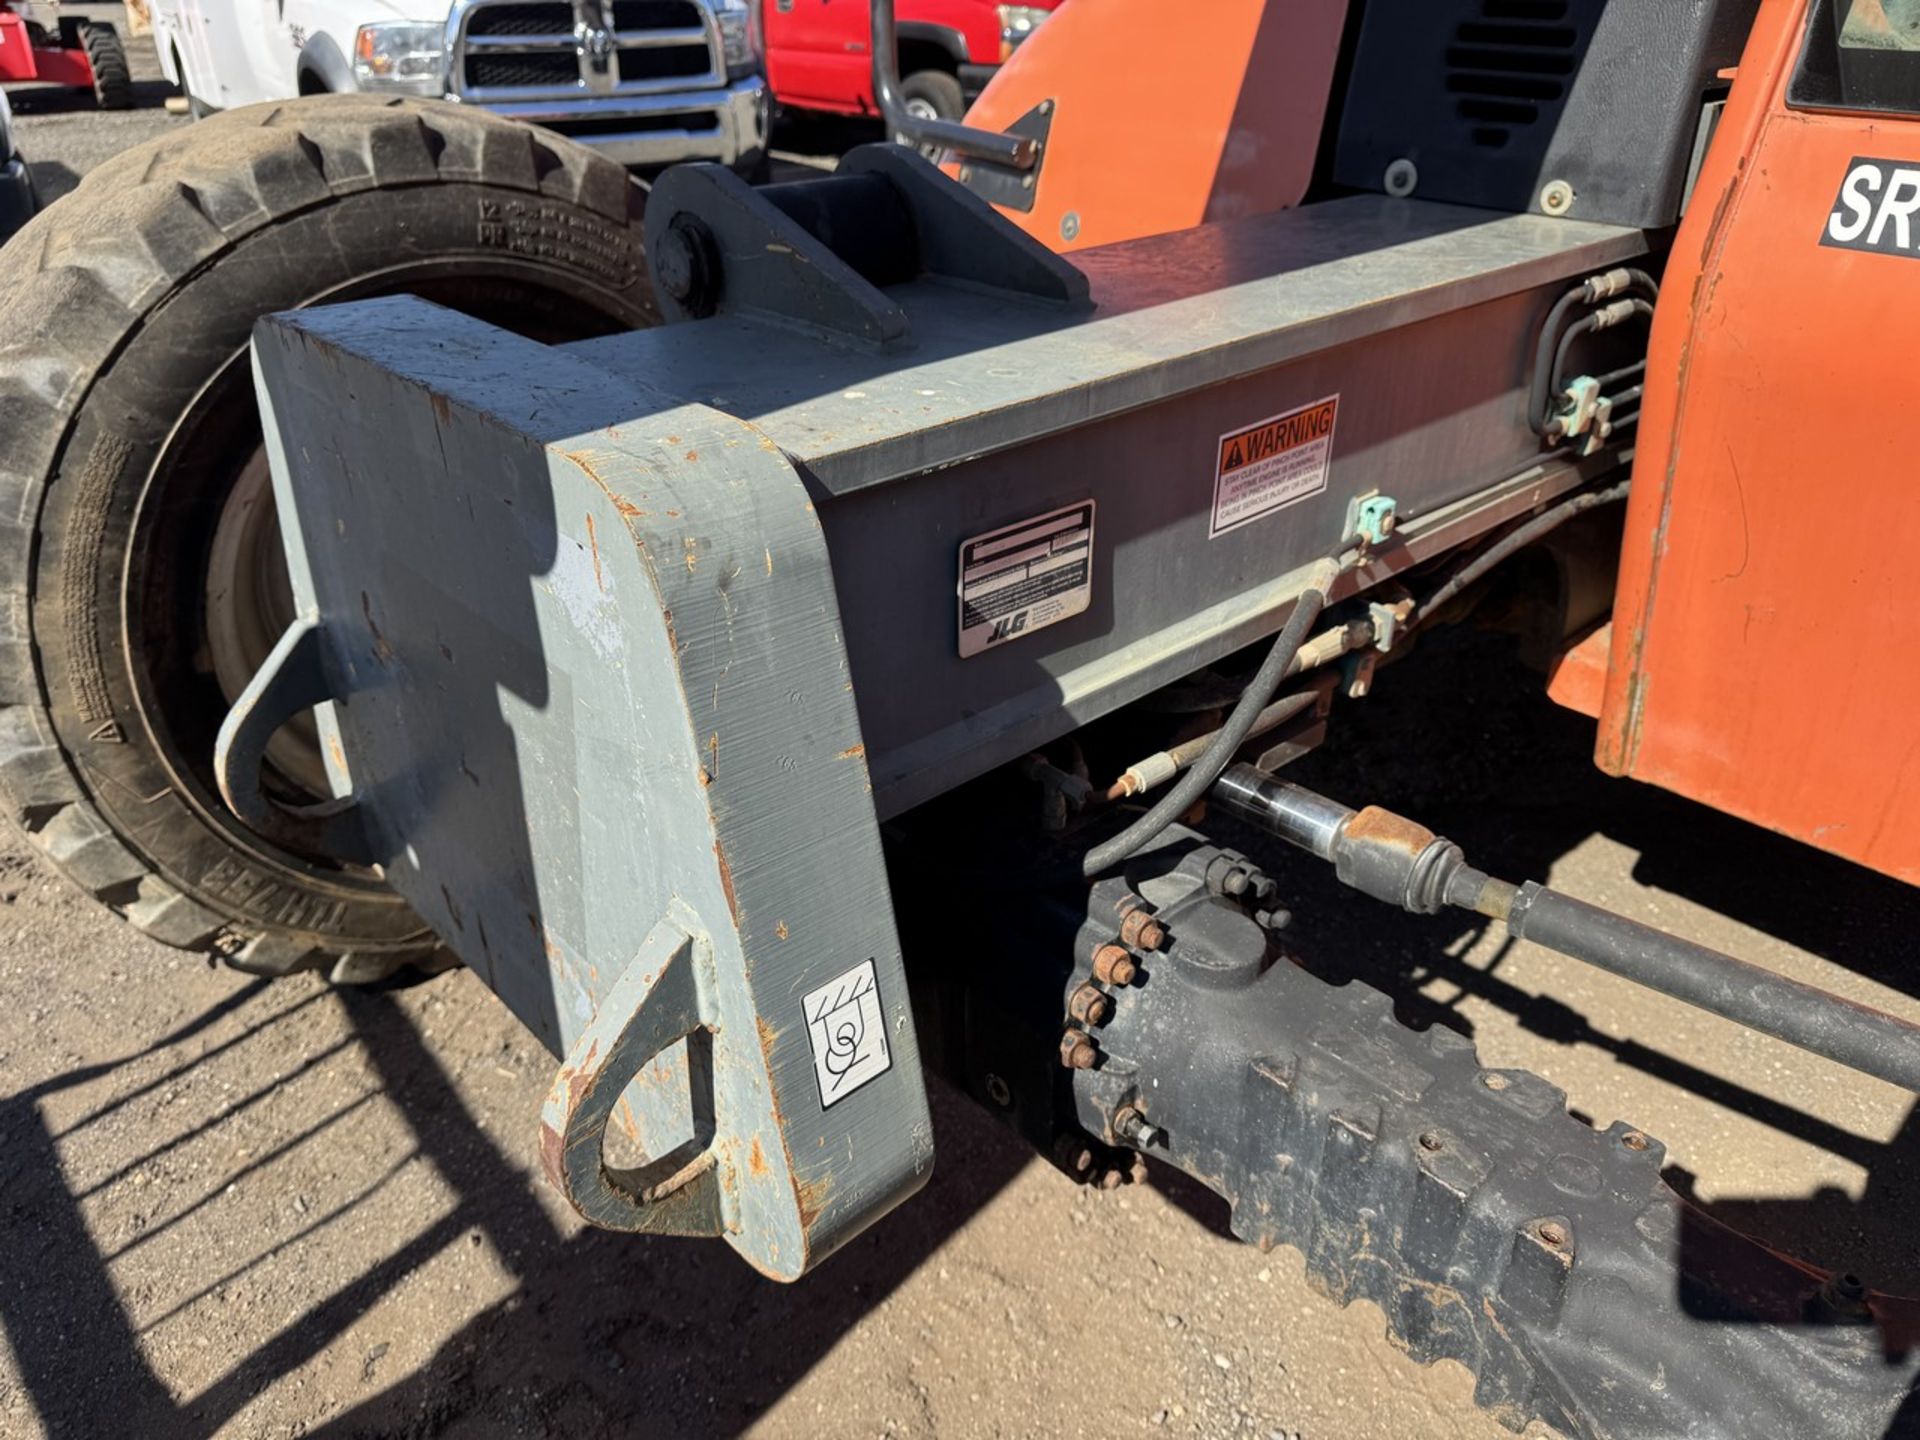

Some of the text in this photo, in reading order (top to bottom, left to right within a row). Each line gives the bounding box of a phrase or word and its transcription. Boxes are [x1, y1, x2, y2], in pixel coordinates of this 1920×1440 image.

[1828, 164, 1920, 249] SR
[1246, 406, 1331, 462] WARNING
[1241, 465, 1260, 480] CLEAR
[1271, 454, 1289, 467] PINCH
[1290, 446, 1308, 460] POINT
[1309, 440, 1324, 452] AREA
[1258, 468, 1280, 483] ENGINE
[1219, 504, 1240, 520] CAUSE
[1242, 493, 1268, 511] SERIOUS
[1269, 484, 1289, 499] INJURY
[1248, 483, 1266, 497] PINCH
[1268, 475, 1285, 489] POINT
[986, 610, 1029, 640] JLG
